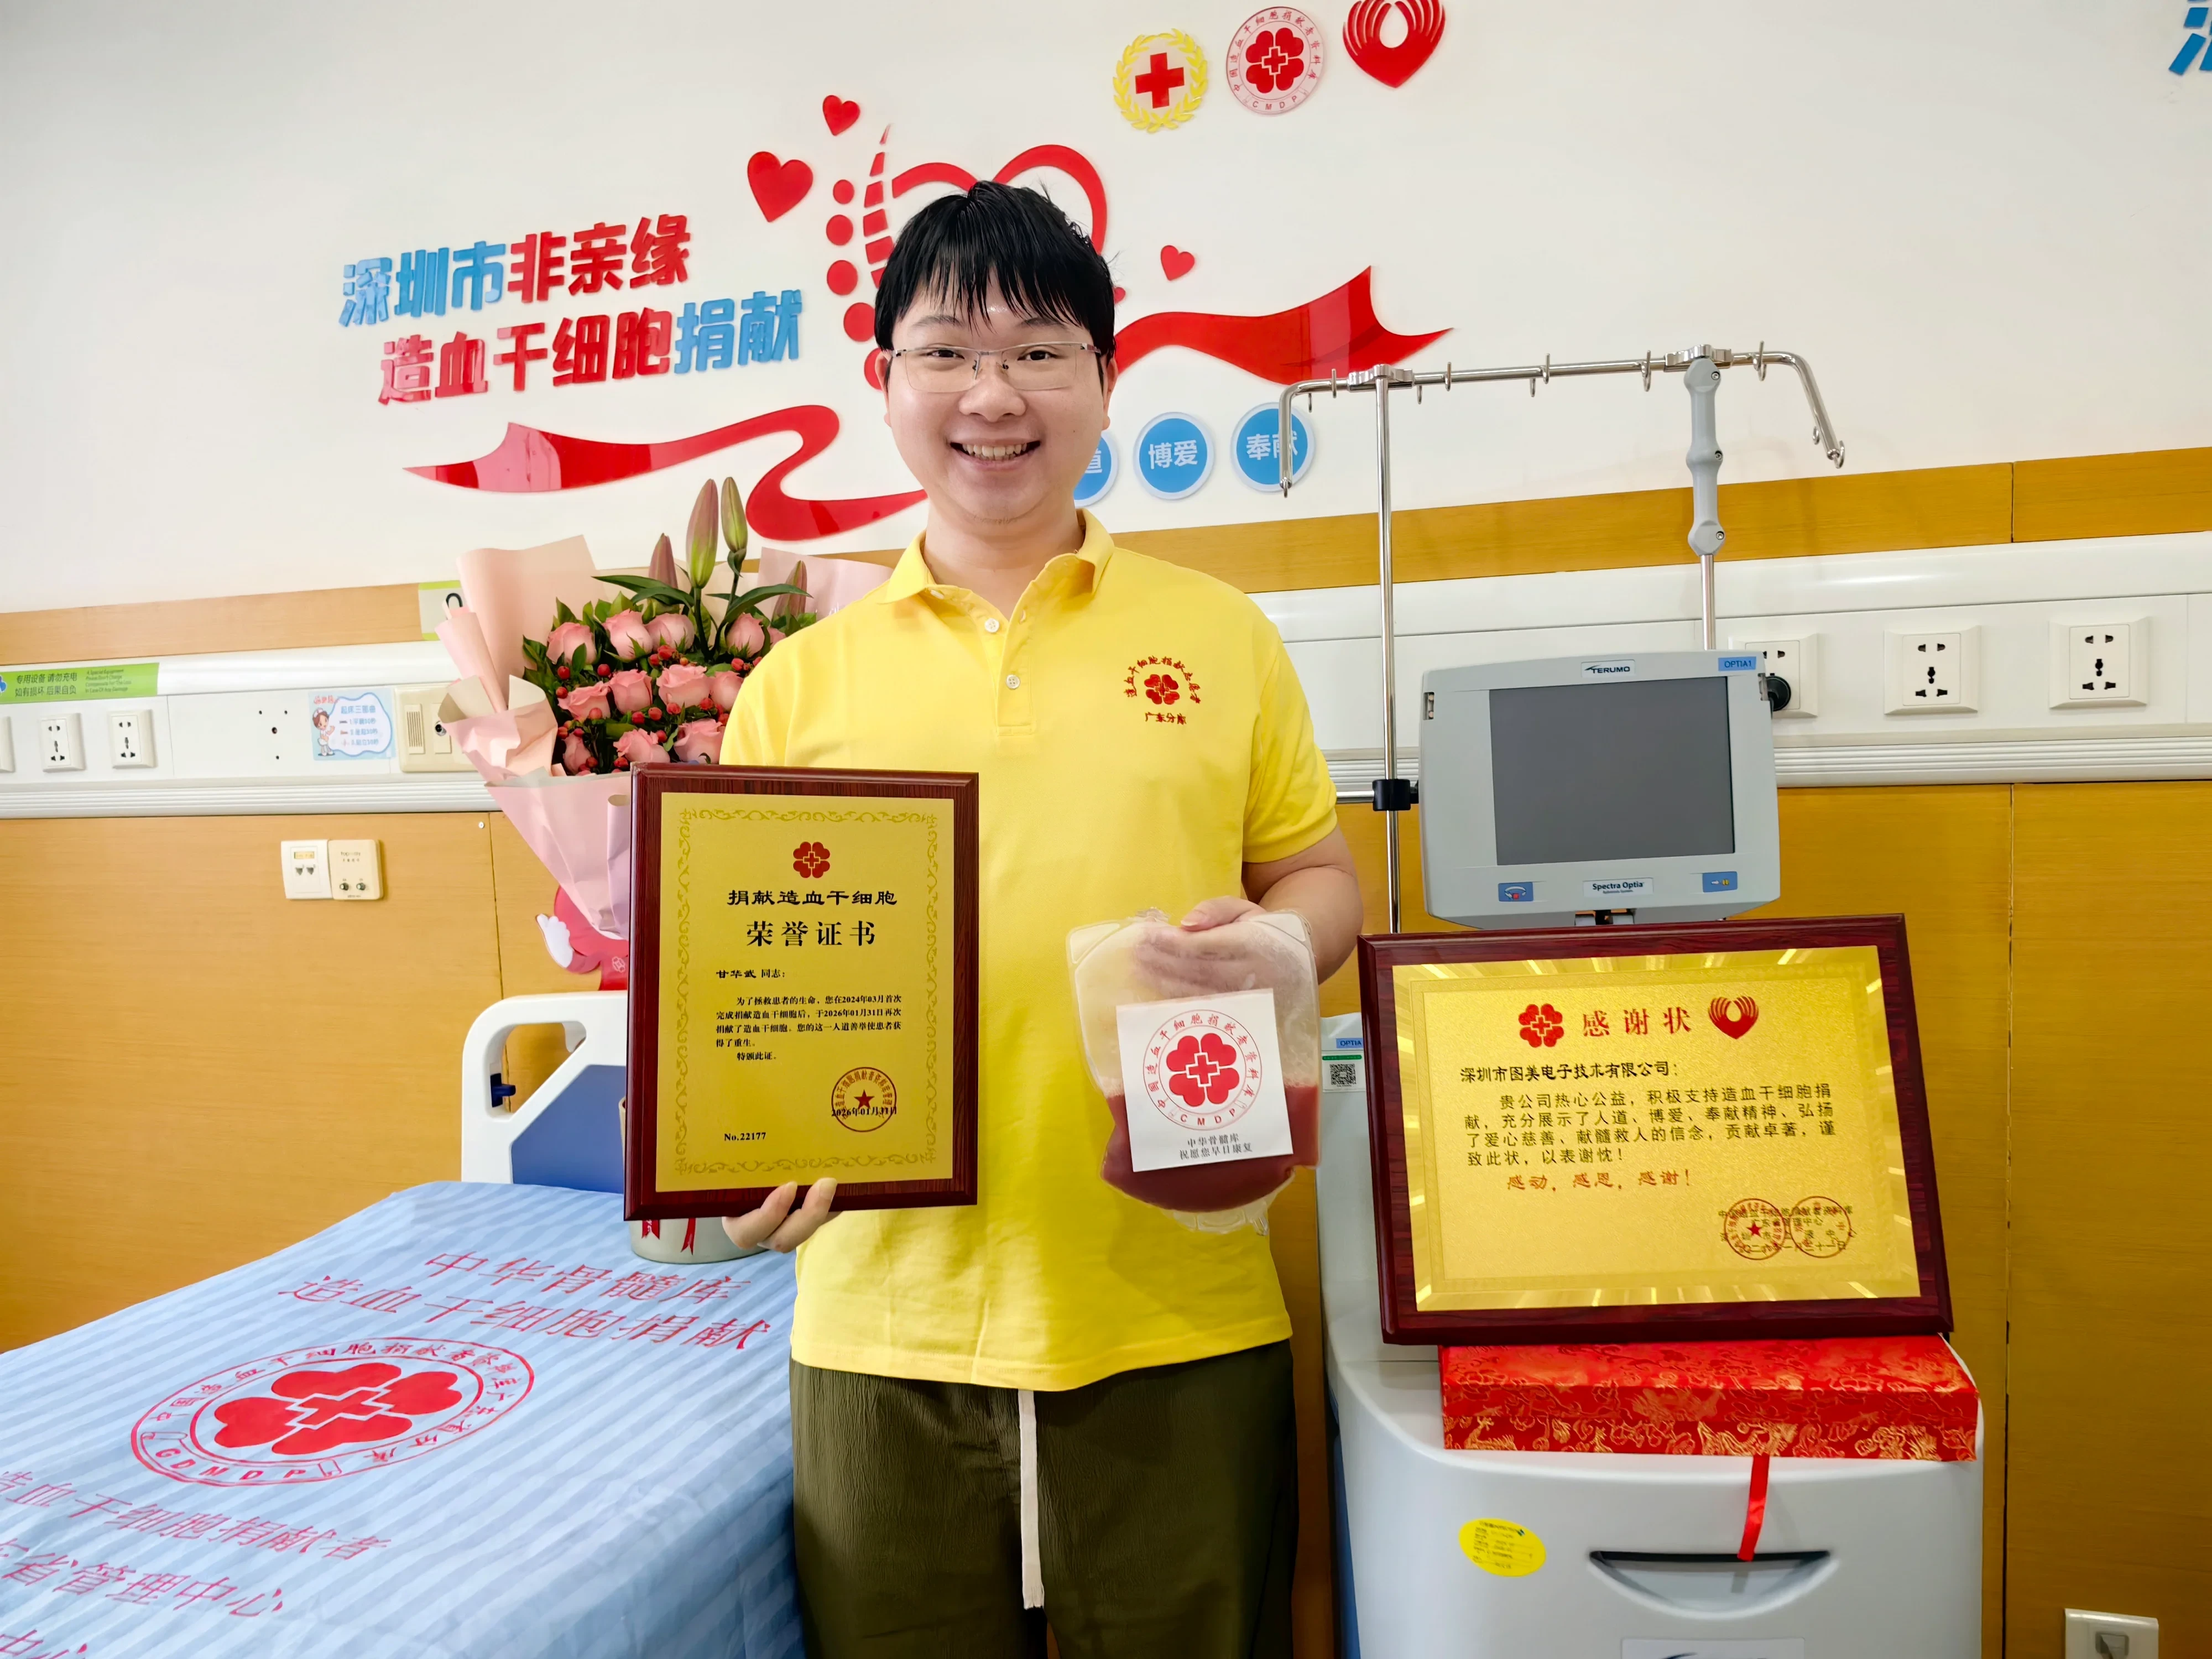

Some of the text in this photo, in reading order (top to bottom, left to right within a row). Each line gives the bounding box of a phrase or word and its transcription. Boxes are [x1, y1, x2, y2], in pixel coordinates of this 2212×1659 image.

[1253, 95, 1297, 110] CMDP
[338, 213, 691, 328] 深圳市非亲缘
[377, 289, 803, 405] 造血干细胞捐献
[1149, 439, 1198, 469] 博爱
[17, 672, 77, 684] 专用设备 请勿充电
[46, 685, 76, 695] 后果自负
[727, 890, 898, 905] 捐献造血干细胞
[1622, 881, 1643, 889] Optia
[747, 920, 875, 947] 荣誉证书
[716, 969, 757, 979] 甘华武
[1583, 1006, 1692, 1037] 感谢状
[1145, 1013, 1259, 1108] 中国造血干细胞捐献者资料库
[1181, 1108, 1236, 1125] CMDP
[724, 1132, 766, 1141] No.22177
[1187, 1133, 1239, 1147] 中华骨髓库
[424, 1251, 751, 1304] 中华骨髓库
[278, 1275, 771, 1350] 造血干细胞捐献
[155, 1448, 306, 1480] GDMDP
[0, 1537, 283, 1617] 省管理中心
